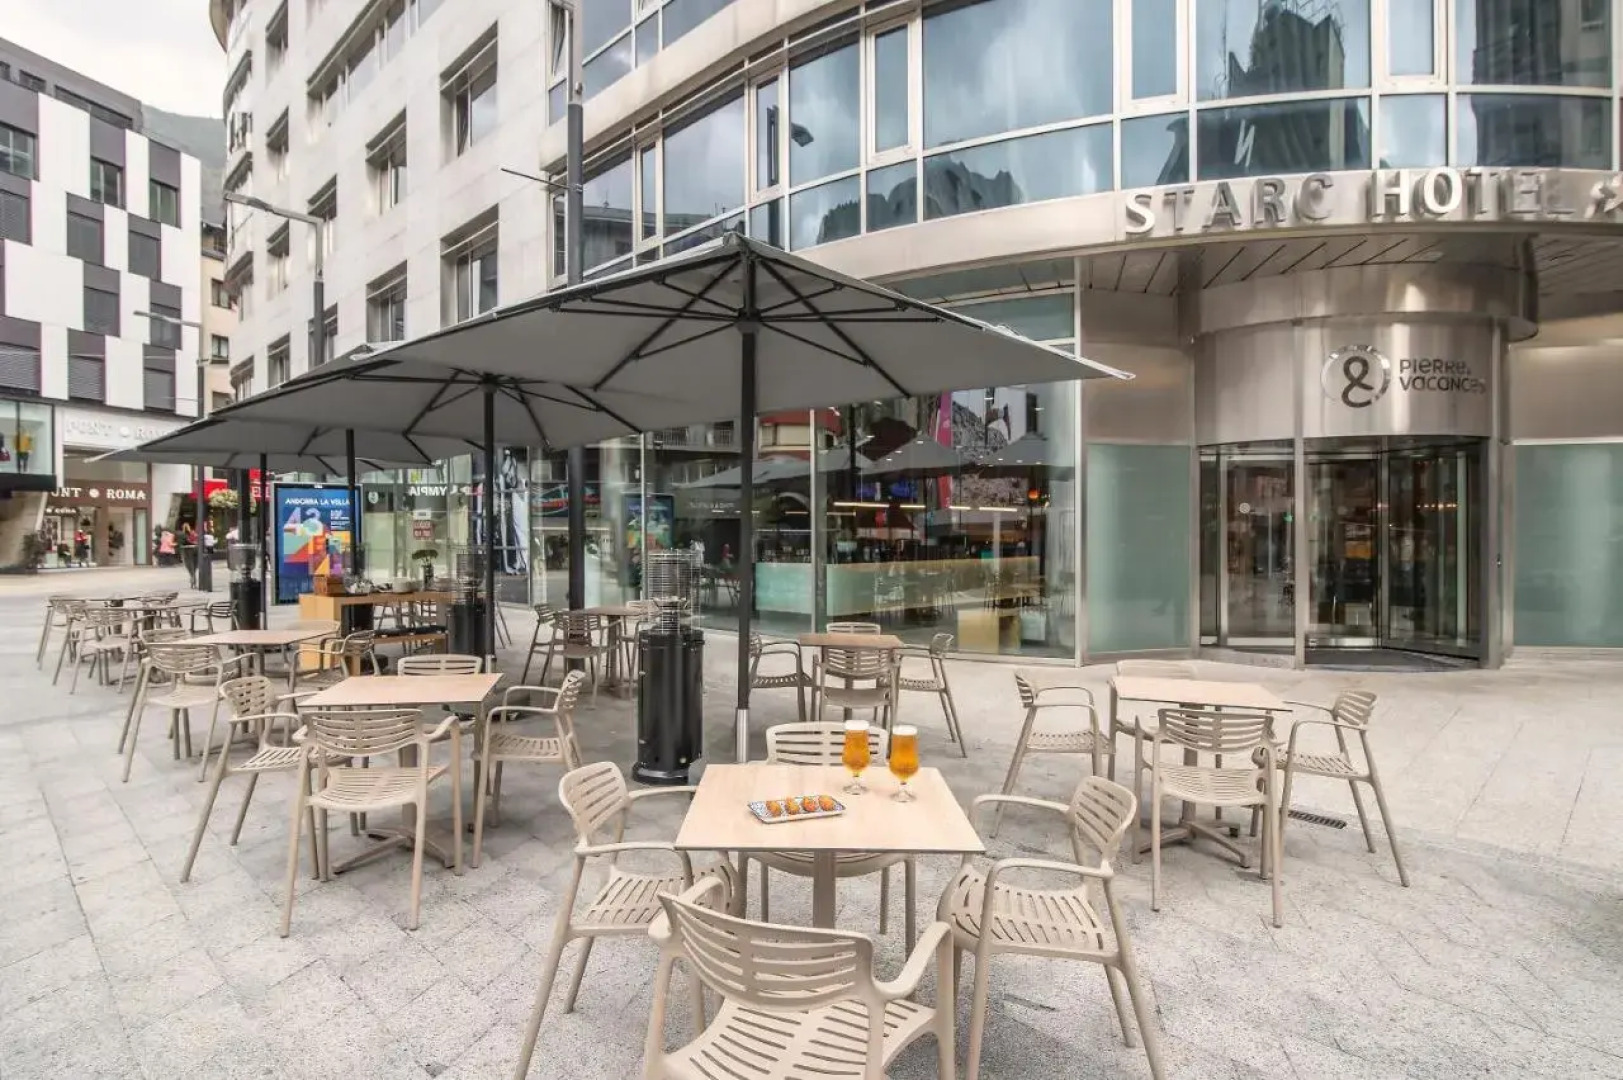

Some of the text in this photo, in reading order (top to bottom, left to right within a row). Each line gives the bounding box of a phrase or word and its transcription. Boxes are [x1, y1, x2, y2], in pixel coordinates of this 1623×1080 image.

[1125, 166, 1576, 235] STARC HOTEL
[106, 488, 147, 500] ROMA
